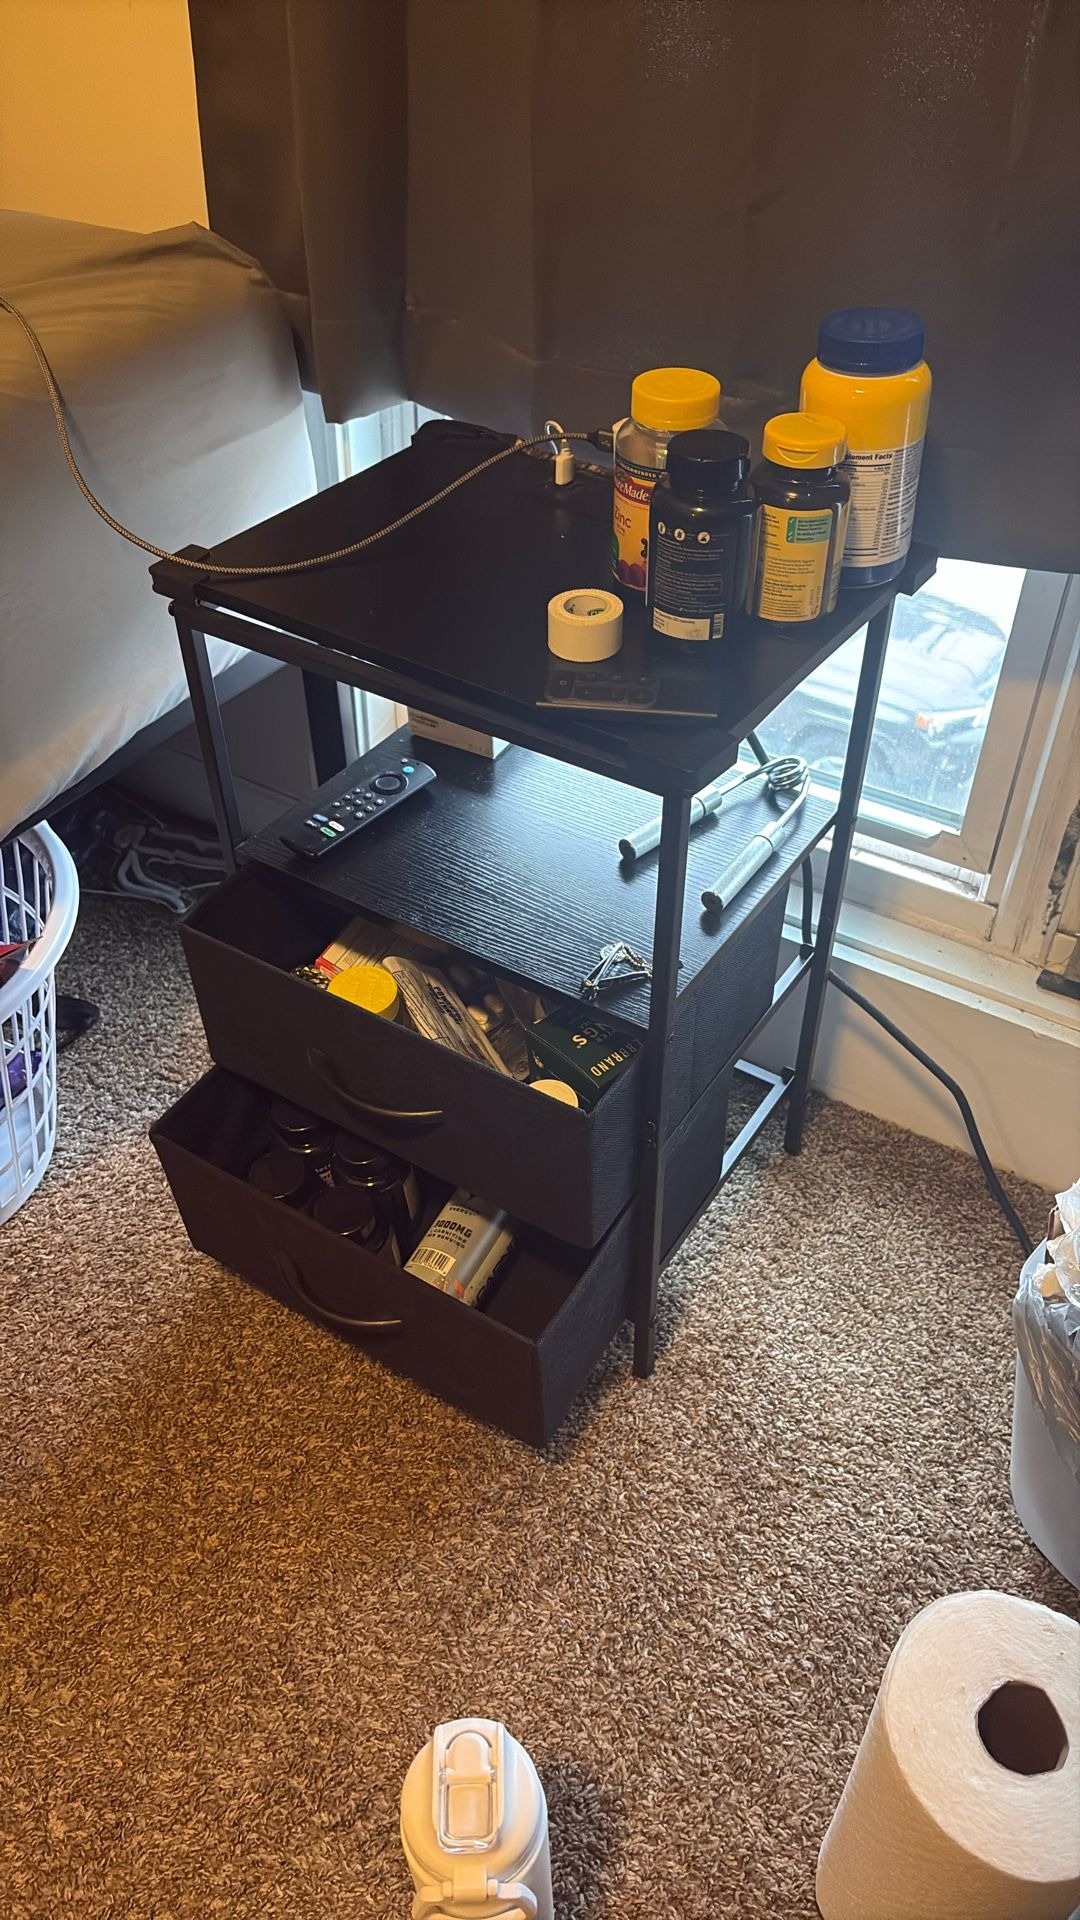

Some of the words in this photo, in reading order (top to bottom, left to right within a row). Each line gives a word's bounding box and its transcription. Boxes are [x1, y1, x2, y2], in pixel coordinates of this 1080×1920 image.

[844, 453, 873, 462] plement
[875, 453, 893, 461] Facts
[614, 505, 632, 528] Zinc
